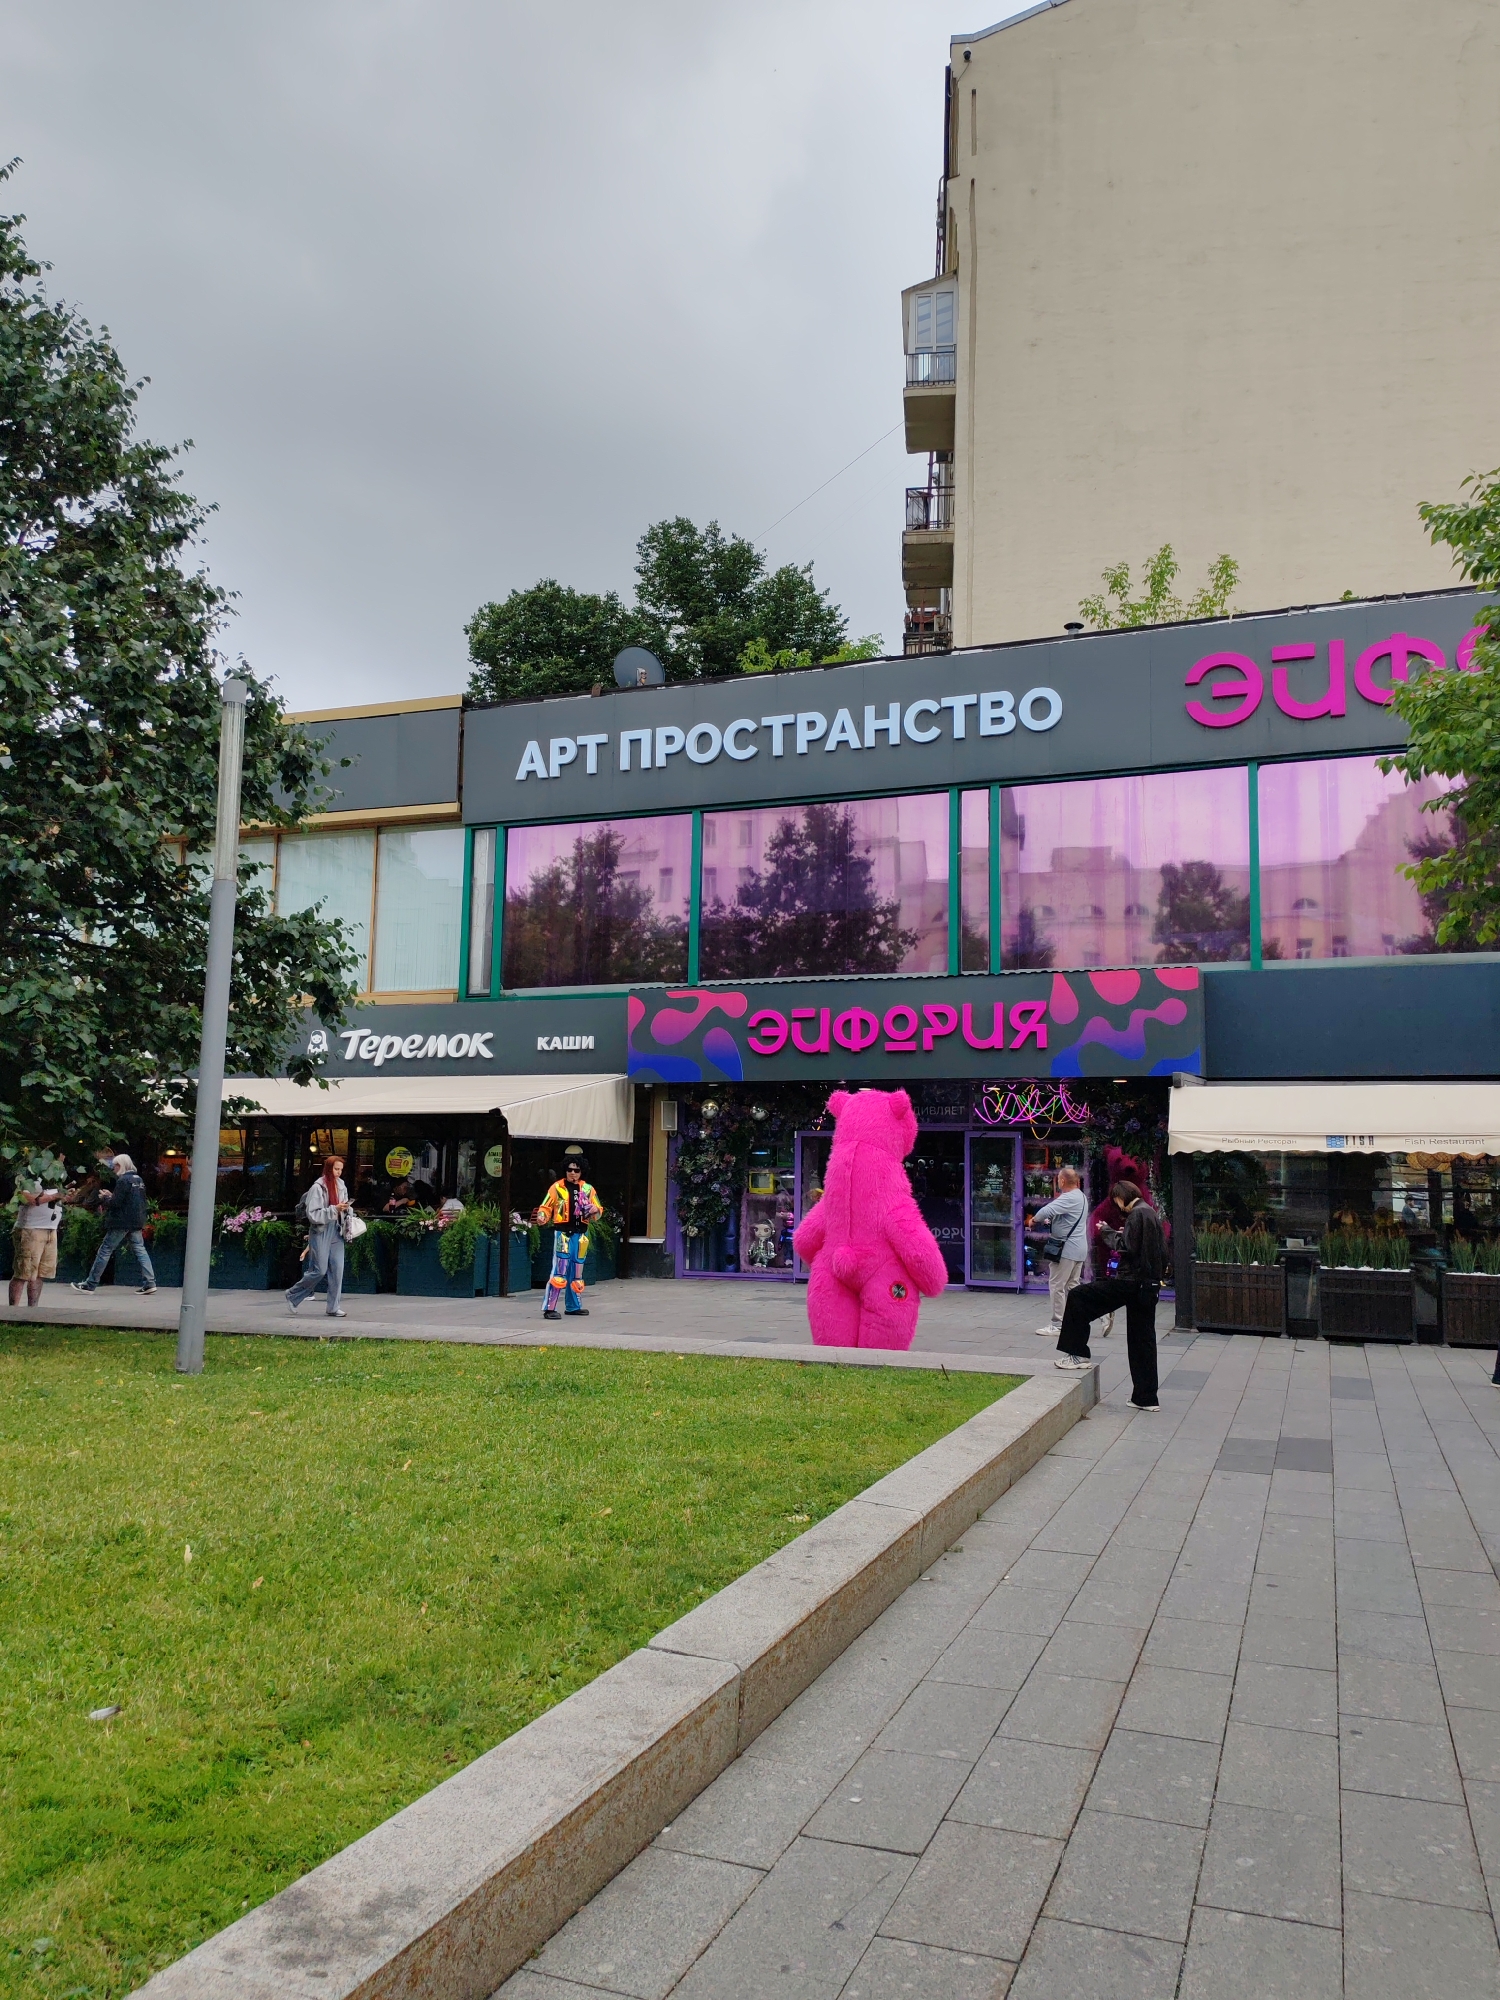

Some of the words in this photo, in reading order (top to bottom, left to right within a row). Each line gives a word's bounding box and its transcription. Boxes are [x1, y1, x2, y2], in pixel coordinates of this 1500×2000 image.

[515, 732, 608, 782] АРТ
[618, 686, 1064, 772] ПРОСТРАНСТВО
[747, 998, 1049, 1058] ЭЙФОРИЯ
[340, 1028, 494, 1067] Теремок
[913, 1105, 966, 1116] ДИВЛЯЕТ
[1221, 1137, 1256, 1145] Рыбный
[1257, 1138, 1297, 1146] Ресторан
[1345, 1134, 1375, 1146] FISH
